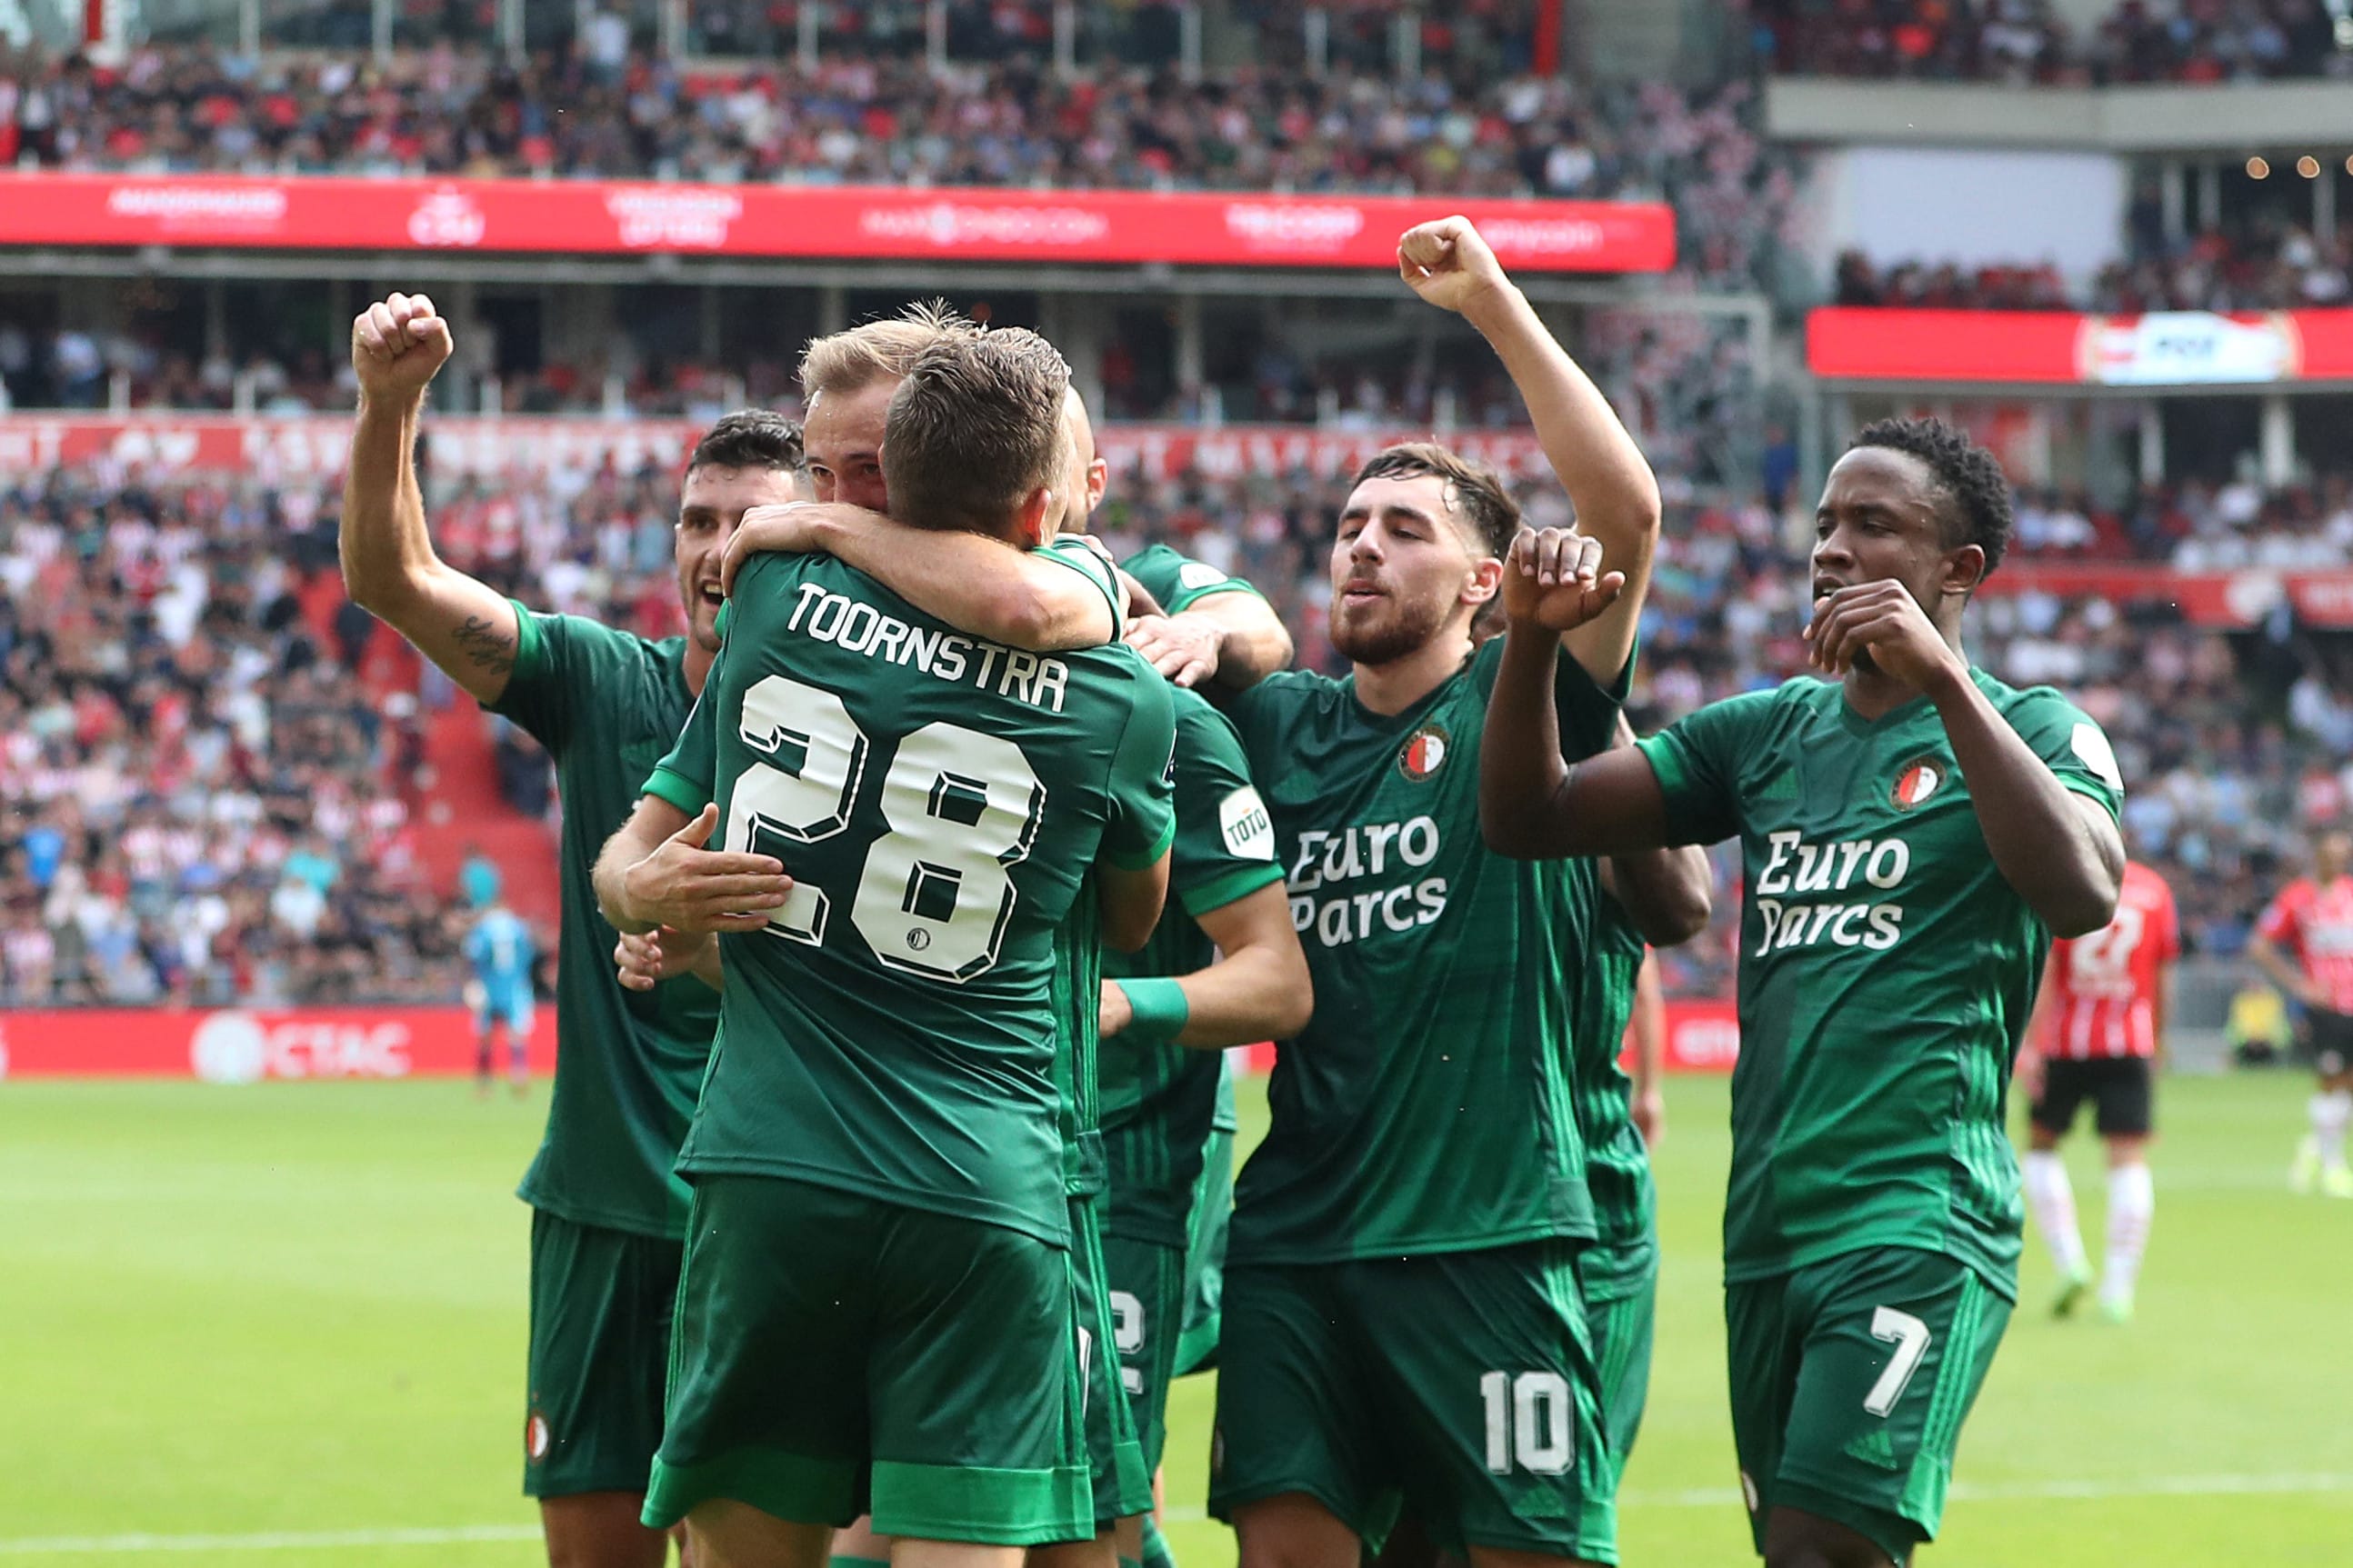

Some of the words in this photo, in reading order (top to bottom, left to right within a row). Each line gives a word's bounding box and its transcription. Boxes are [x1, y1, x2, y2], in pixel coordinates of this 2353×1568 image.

[787, 583, 1069, 713] TOORNSTRA
[723, 674, 1047, 985] 28
[1227, 808, 1267, 847] TOTO
[1287, 815, 1440, 894] Euro
[1756, 830, 1910, 895] Euro
[1755, 898, 1904, 957] Parcs
[266, 1023, 412, 1077] CTAC
[1863, 1304, 1932, 1418] 7
[1480, 1370, 1575, 1475] 10
